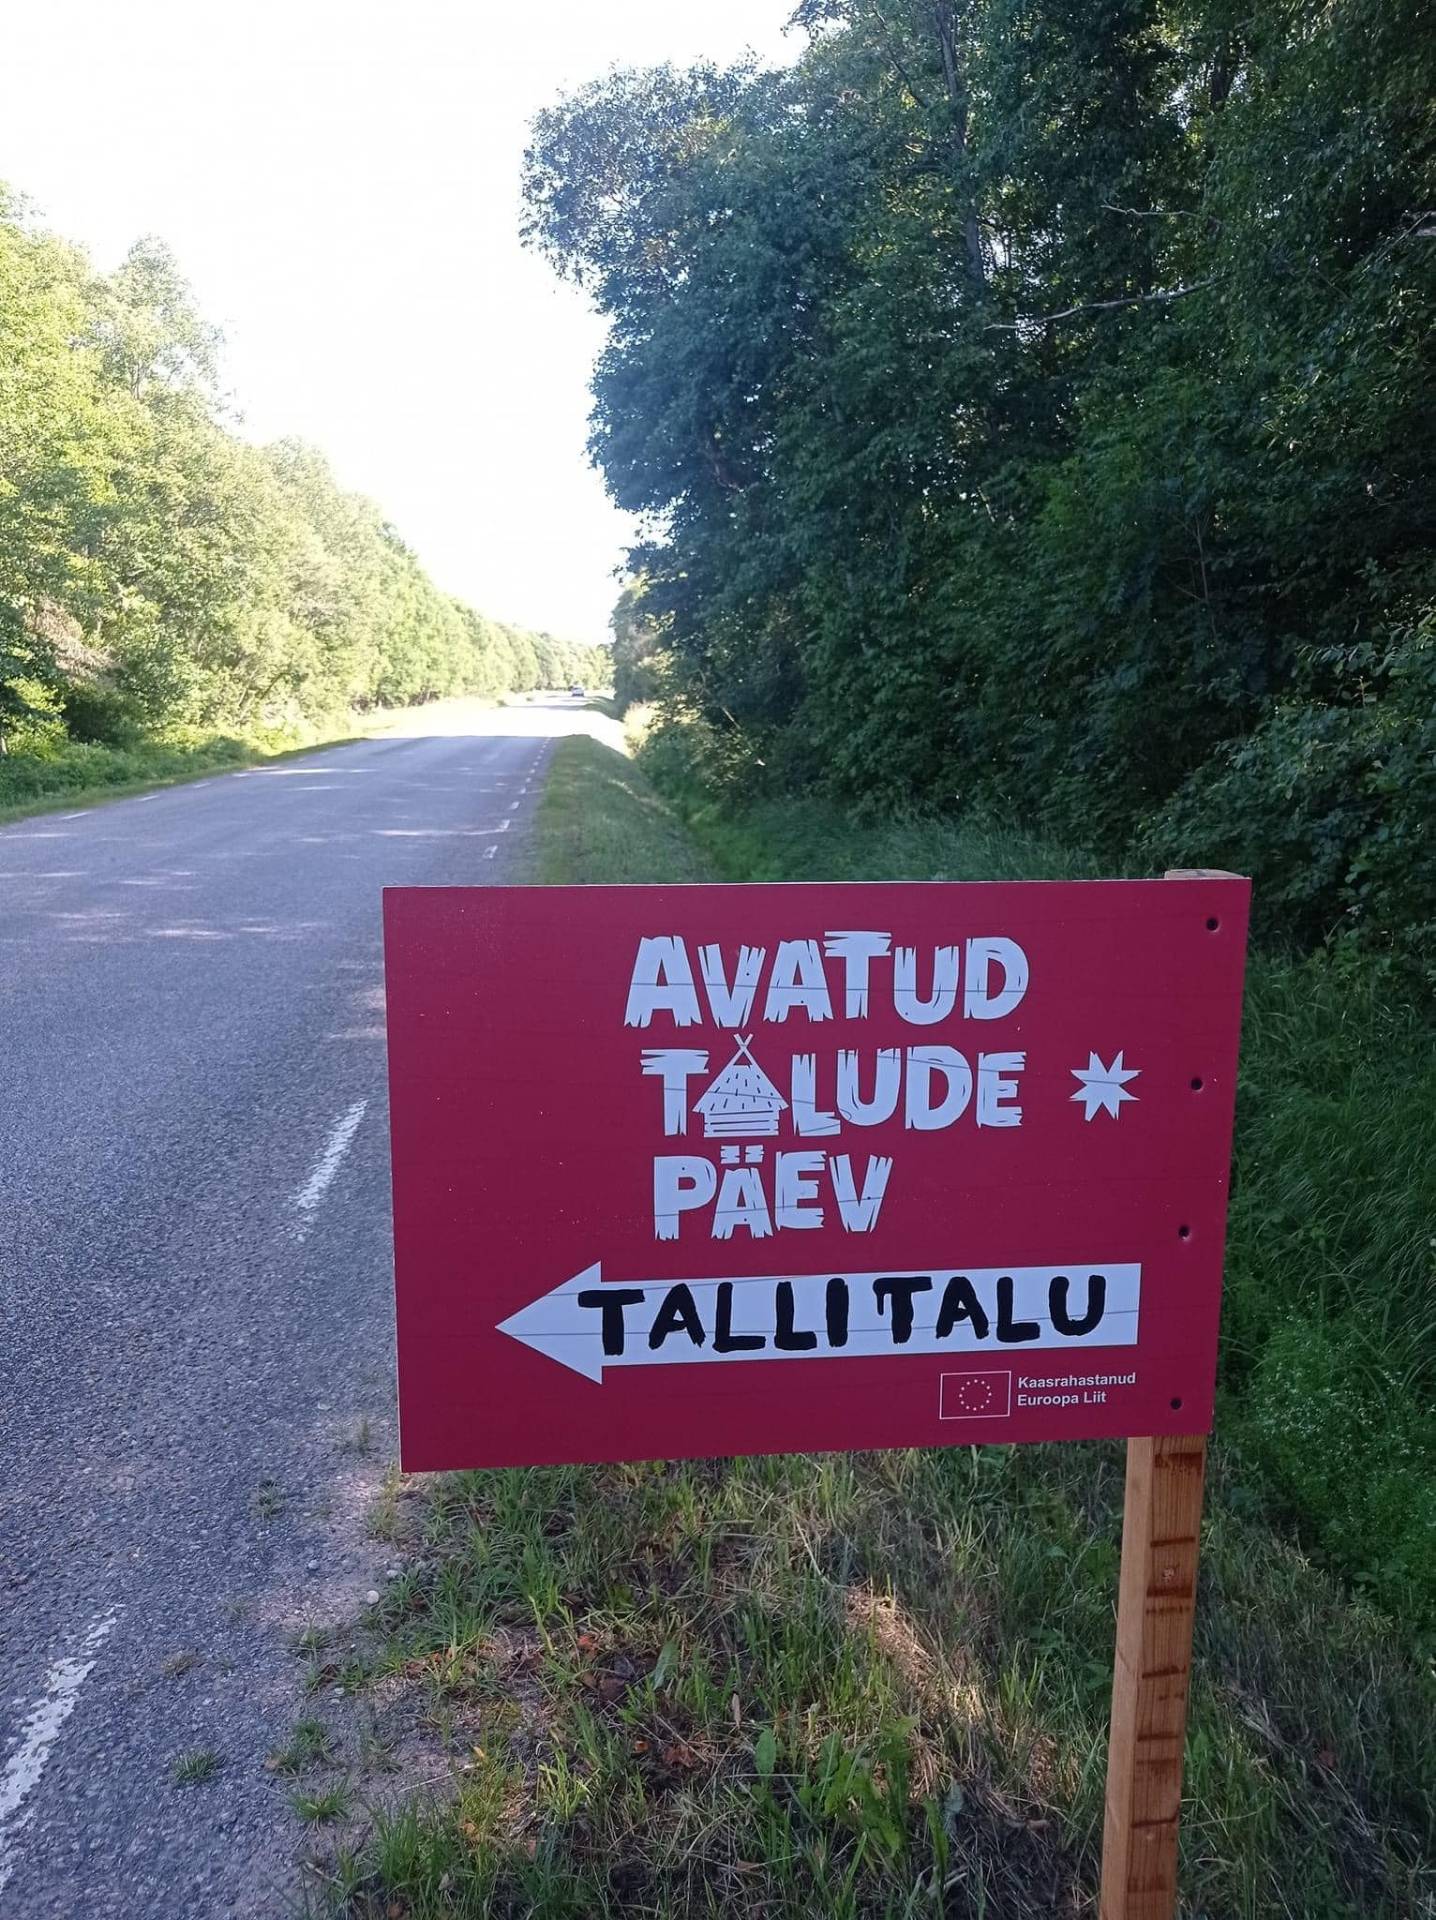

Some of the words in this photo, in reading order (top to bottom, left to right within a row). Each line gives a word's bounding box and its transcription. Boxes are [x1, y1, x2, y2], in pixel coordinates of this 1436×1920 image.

[624, 931, 1029, 1028] AVATUD
[653, 1144, 894, 1241] PÄEV
[1017, 1394, 1079, 1408] Euroopa
[1083, 1391, 1107, 1403] Liit
[1018, 1372, 1137, 1389] Kaasrahastanud
